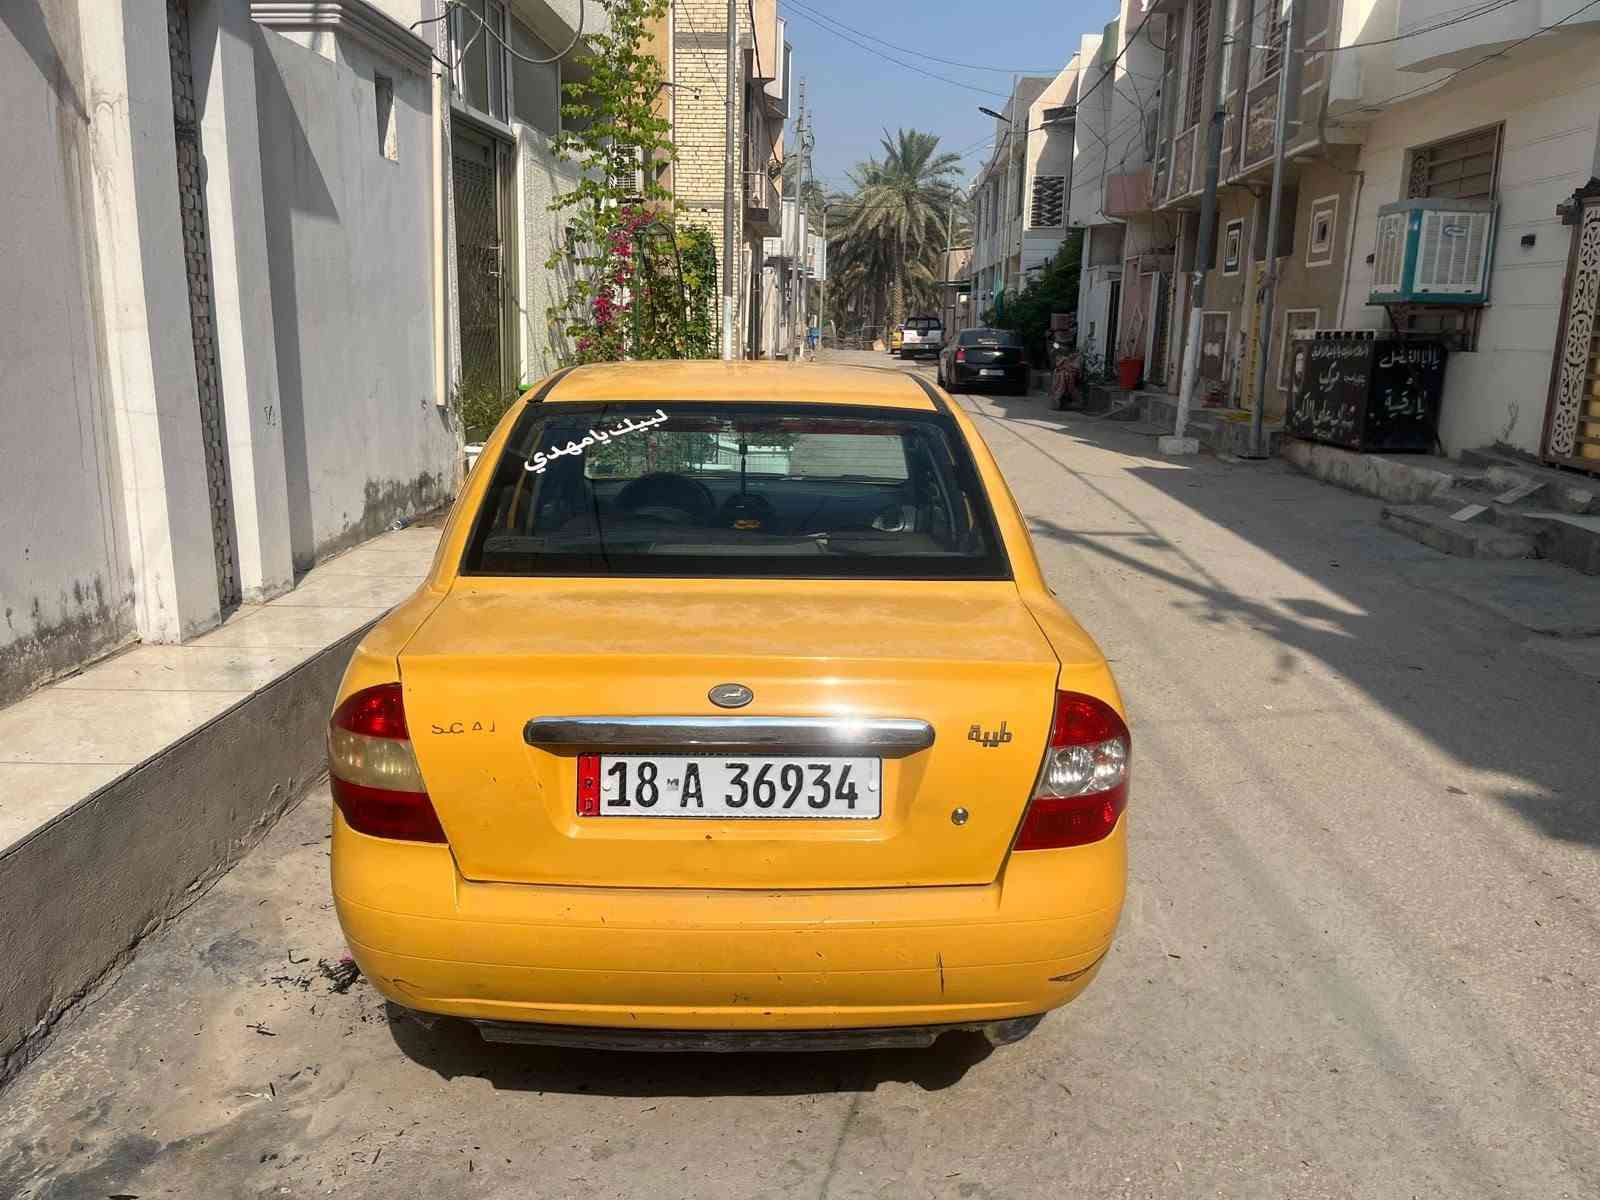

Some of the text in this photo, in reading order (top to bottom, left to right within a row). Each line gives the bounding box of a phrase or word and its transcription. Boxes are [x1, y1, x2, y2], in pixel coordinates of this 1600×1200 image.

[968, 720, 1013, 747] طيبة
[607, 761, 859, 809] 18 A 36934
